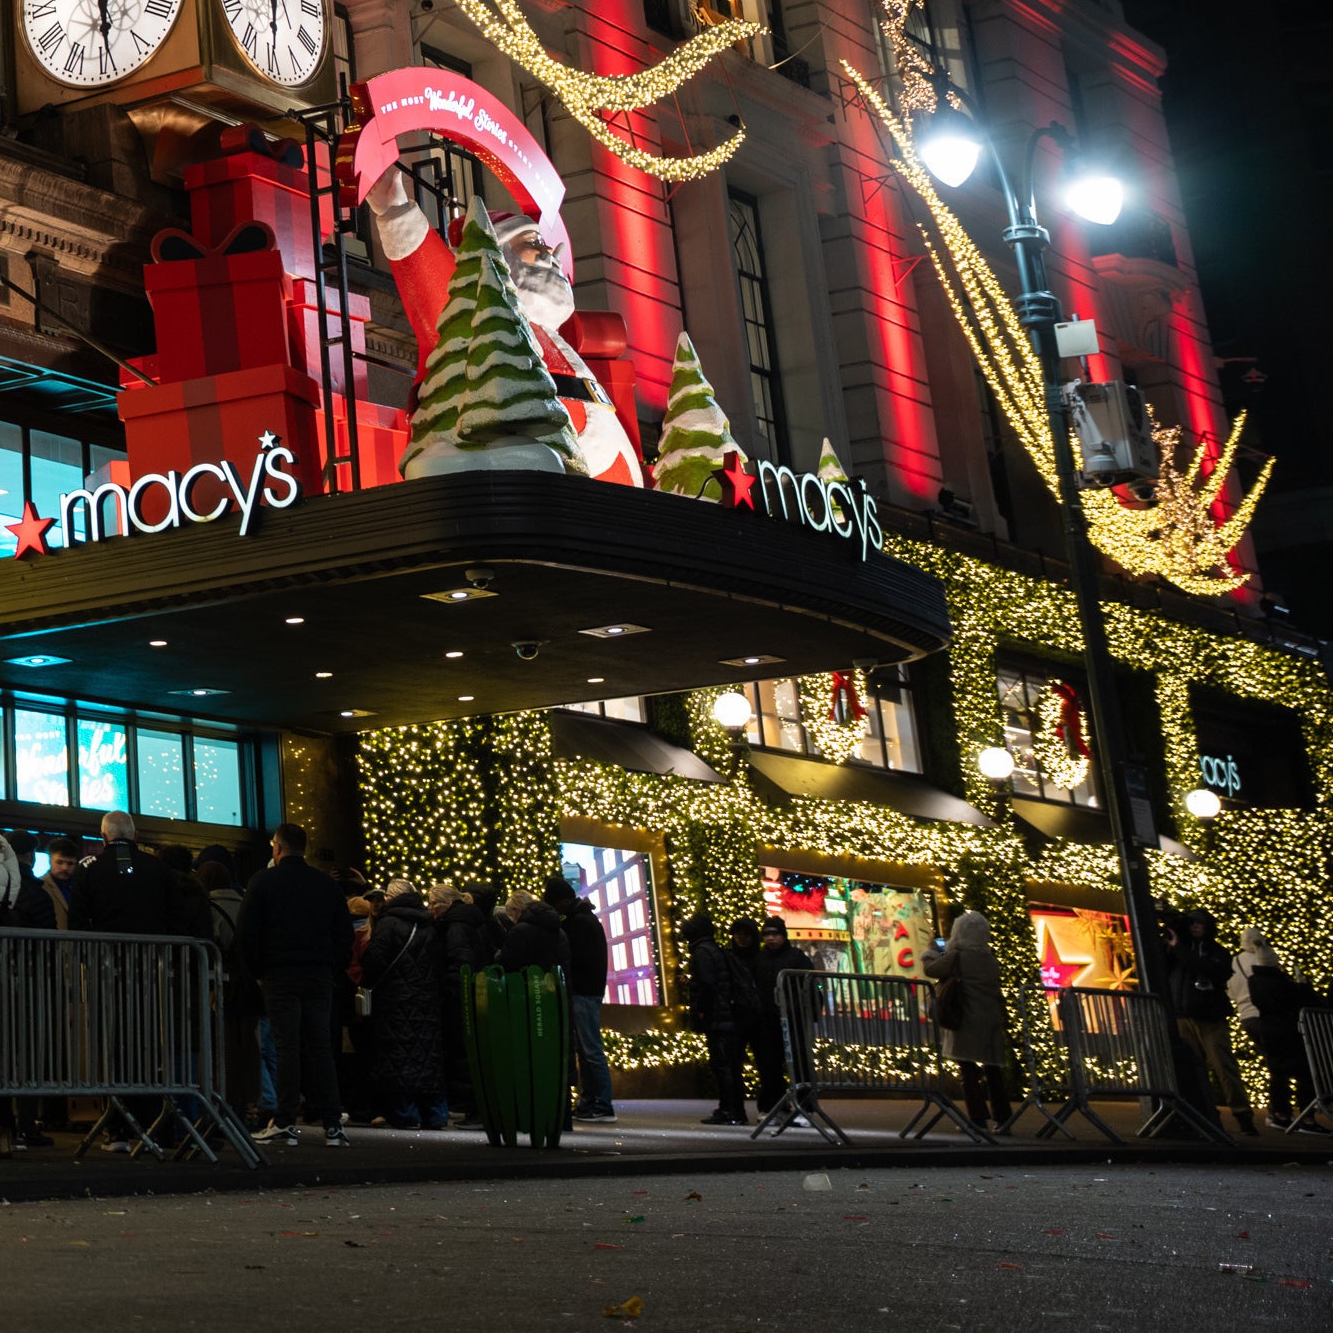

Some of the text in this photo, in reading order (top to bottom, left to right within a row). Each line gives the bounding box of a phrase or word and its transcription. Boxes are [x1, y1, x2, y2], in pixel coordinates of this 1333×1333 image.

[424, 87, 475, 120] Wonderful
[474, 108, 508, 145] Stories
[59, 428, 299, 549] macy's
[757, 459, 883, 562] macy's
[16, 729, 126, 783] Wondrful
[1199, 754, 1242, 797] acy's
